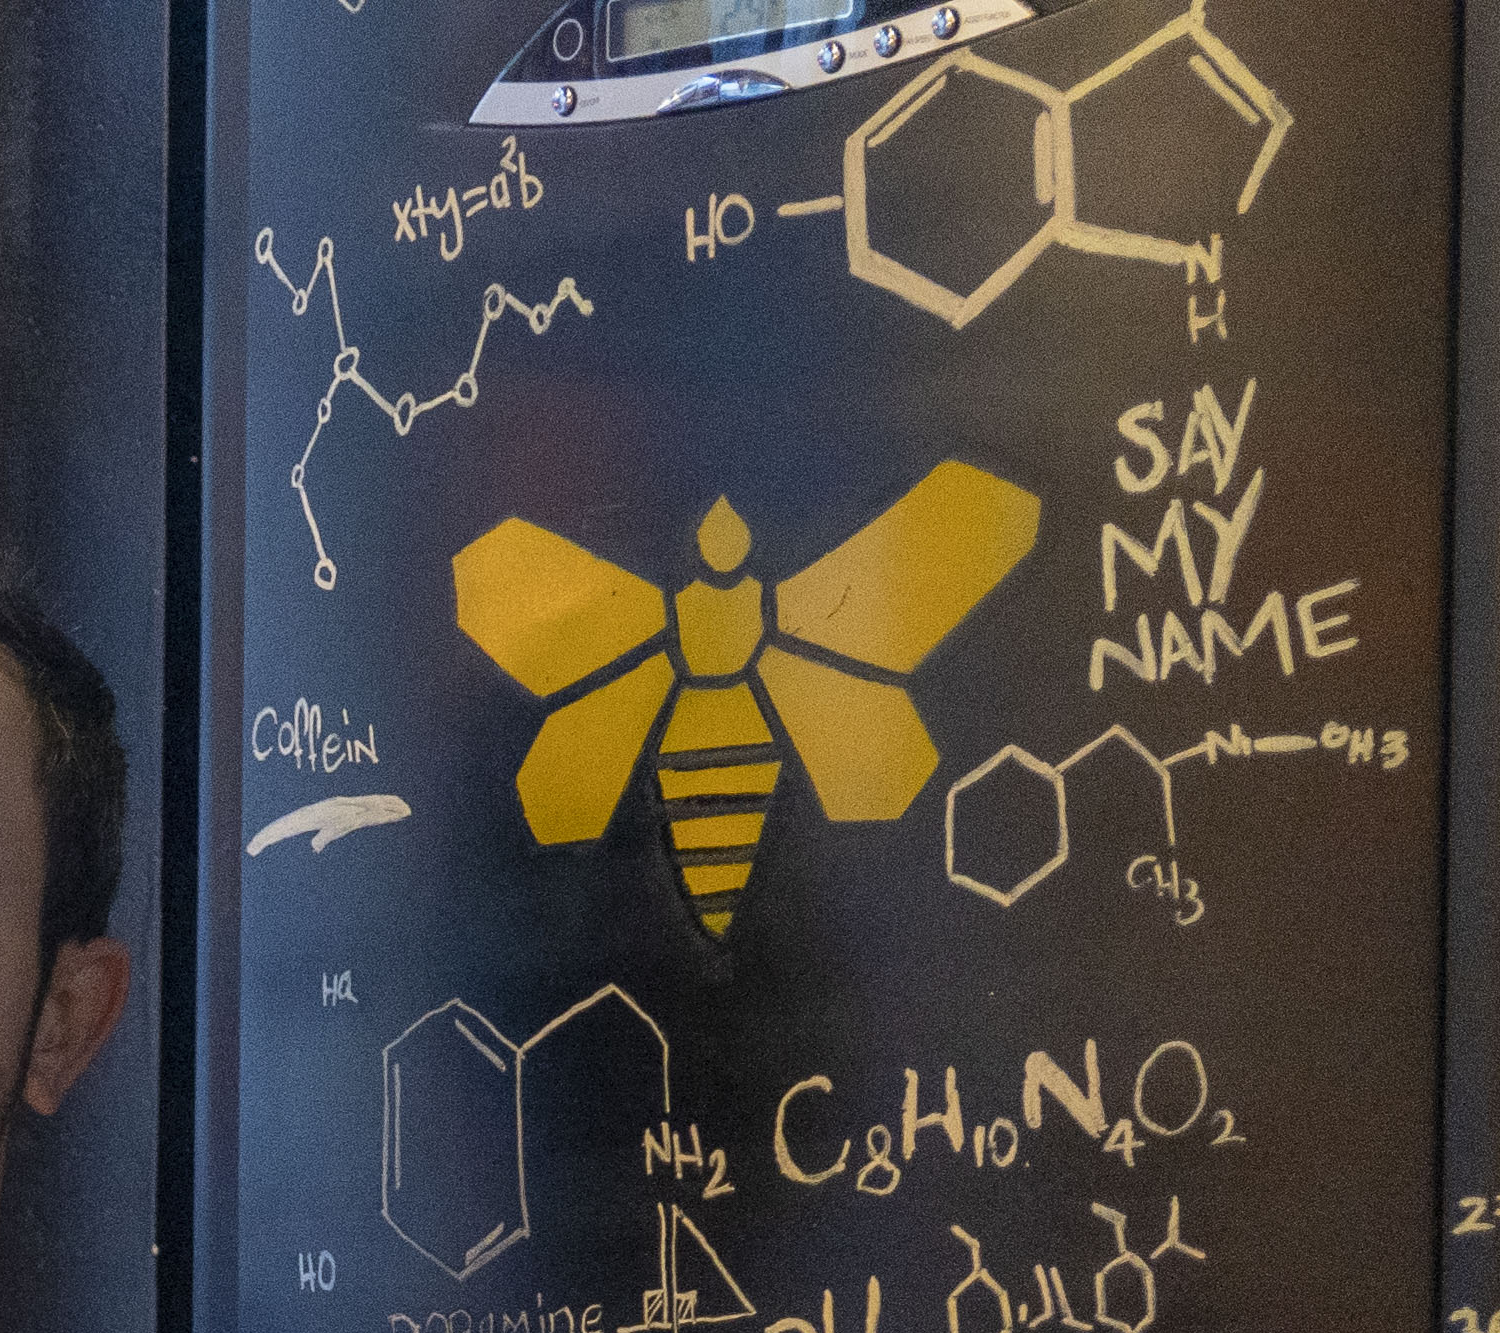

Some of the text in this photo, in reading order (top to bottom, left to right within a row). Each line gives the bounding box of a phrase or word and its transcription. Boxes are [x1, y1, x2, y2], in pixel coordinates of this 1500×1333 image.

[685, 193, 756, 262] HO
[1114, 378, 1256, 494] SAY
[1102, 467, 1264, 612] MY
[1089, 577, 1360, 691] NAME
[298, 1250, 336, 1294] HO
